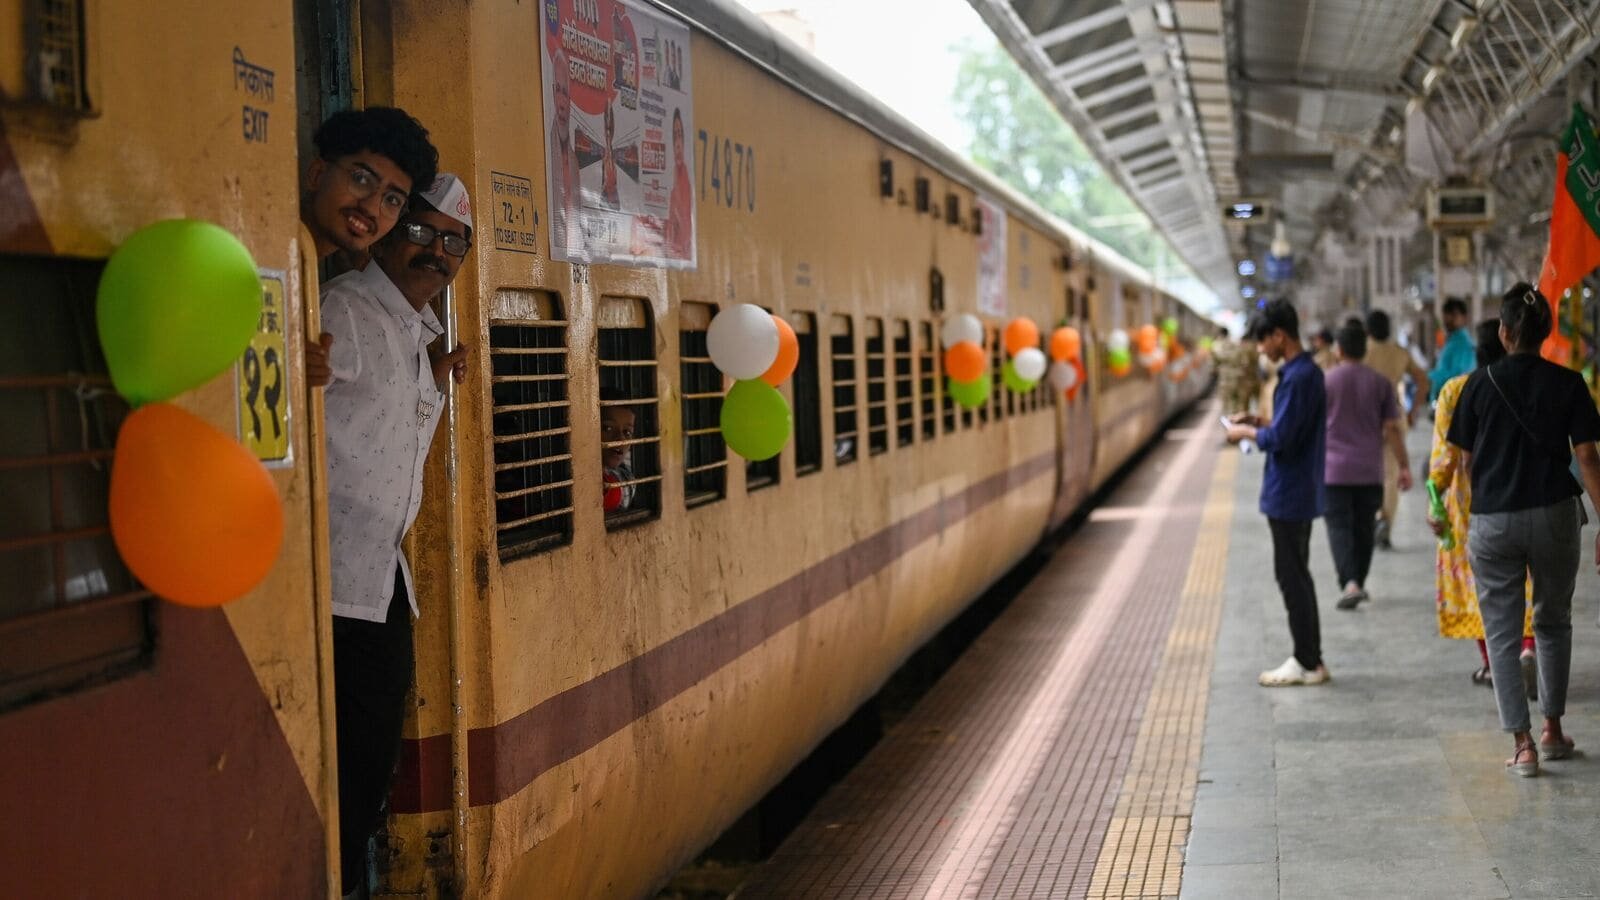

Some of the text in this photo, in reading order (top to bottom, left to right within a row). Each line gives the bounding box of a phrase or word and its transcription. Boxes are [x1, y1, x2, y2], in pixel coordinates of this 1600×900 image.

[233, 45, 275, 104] निकास
[242, 104, 269, 144] EXIT
[698, 128, 756, 215] 74870
[496, 227, 504, 243] TO
[504, 229, 517, 245] SEAT
